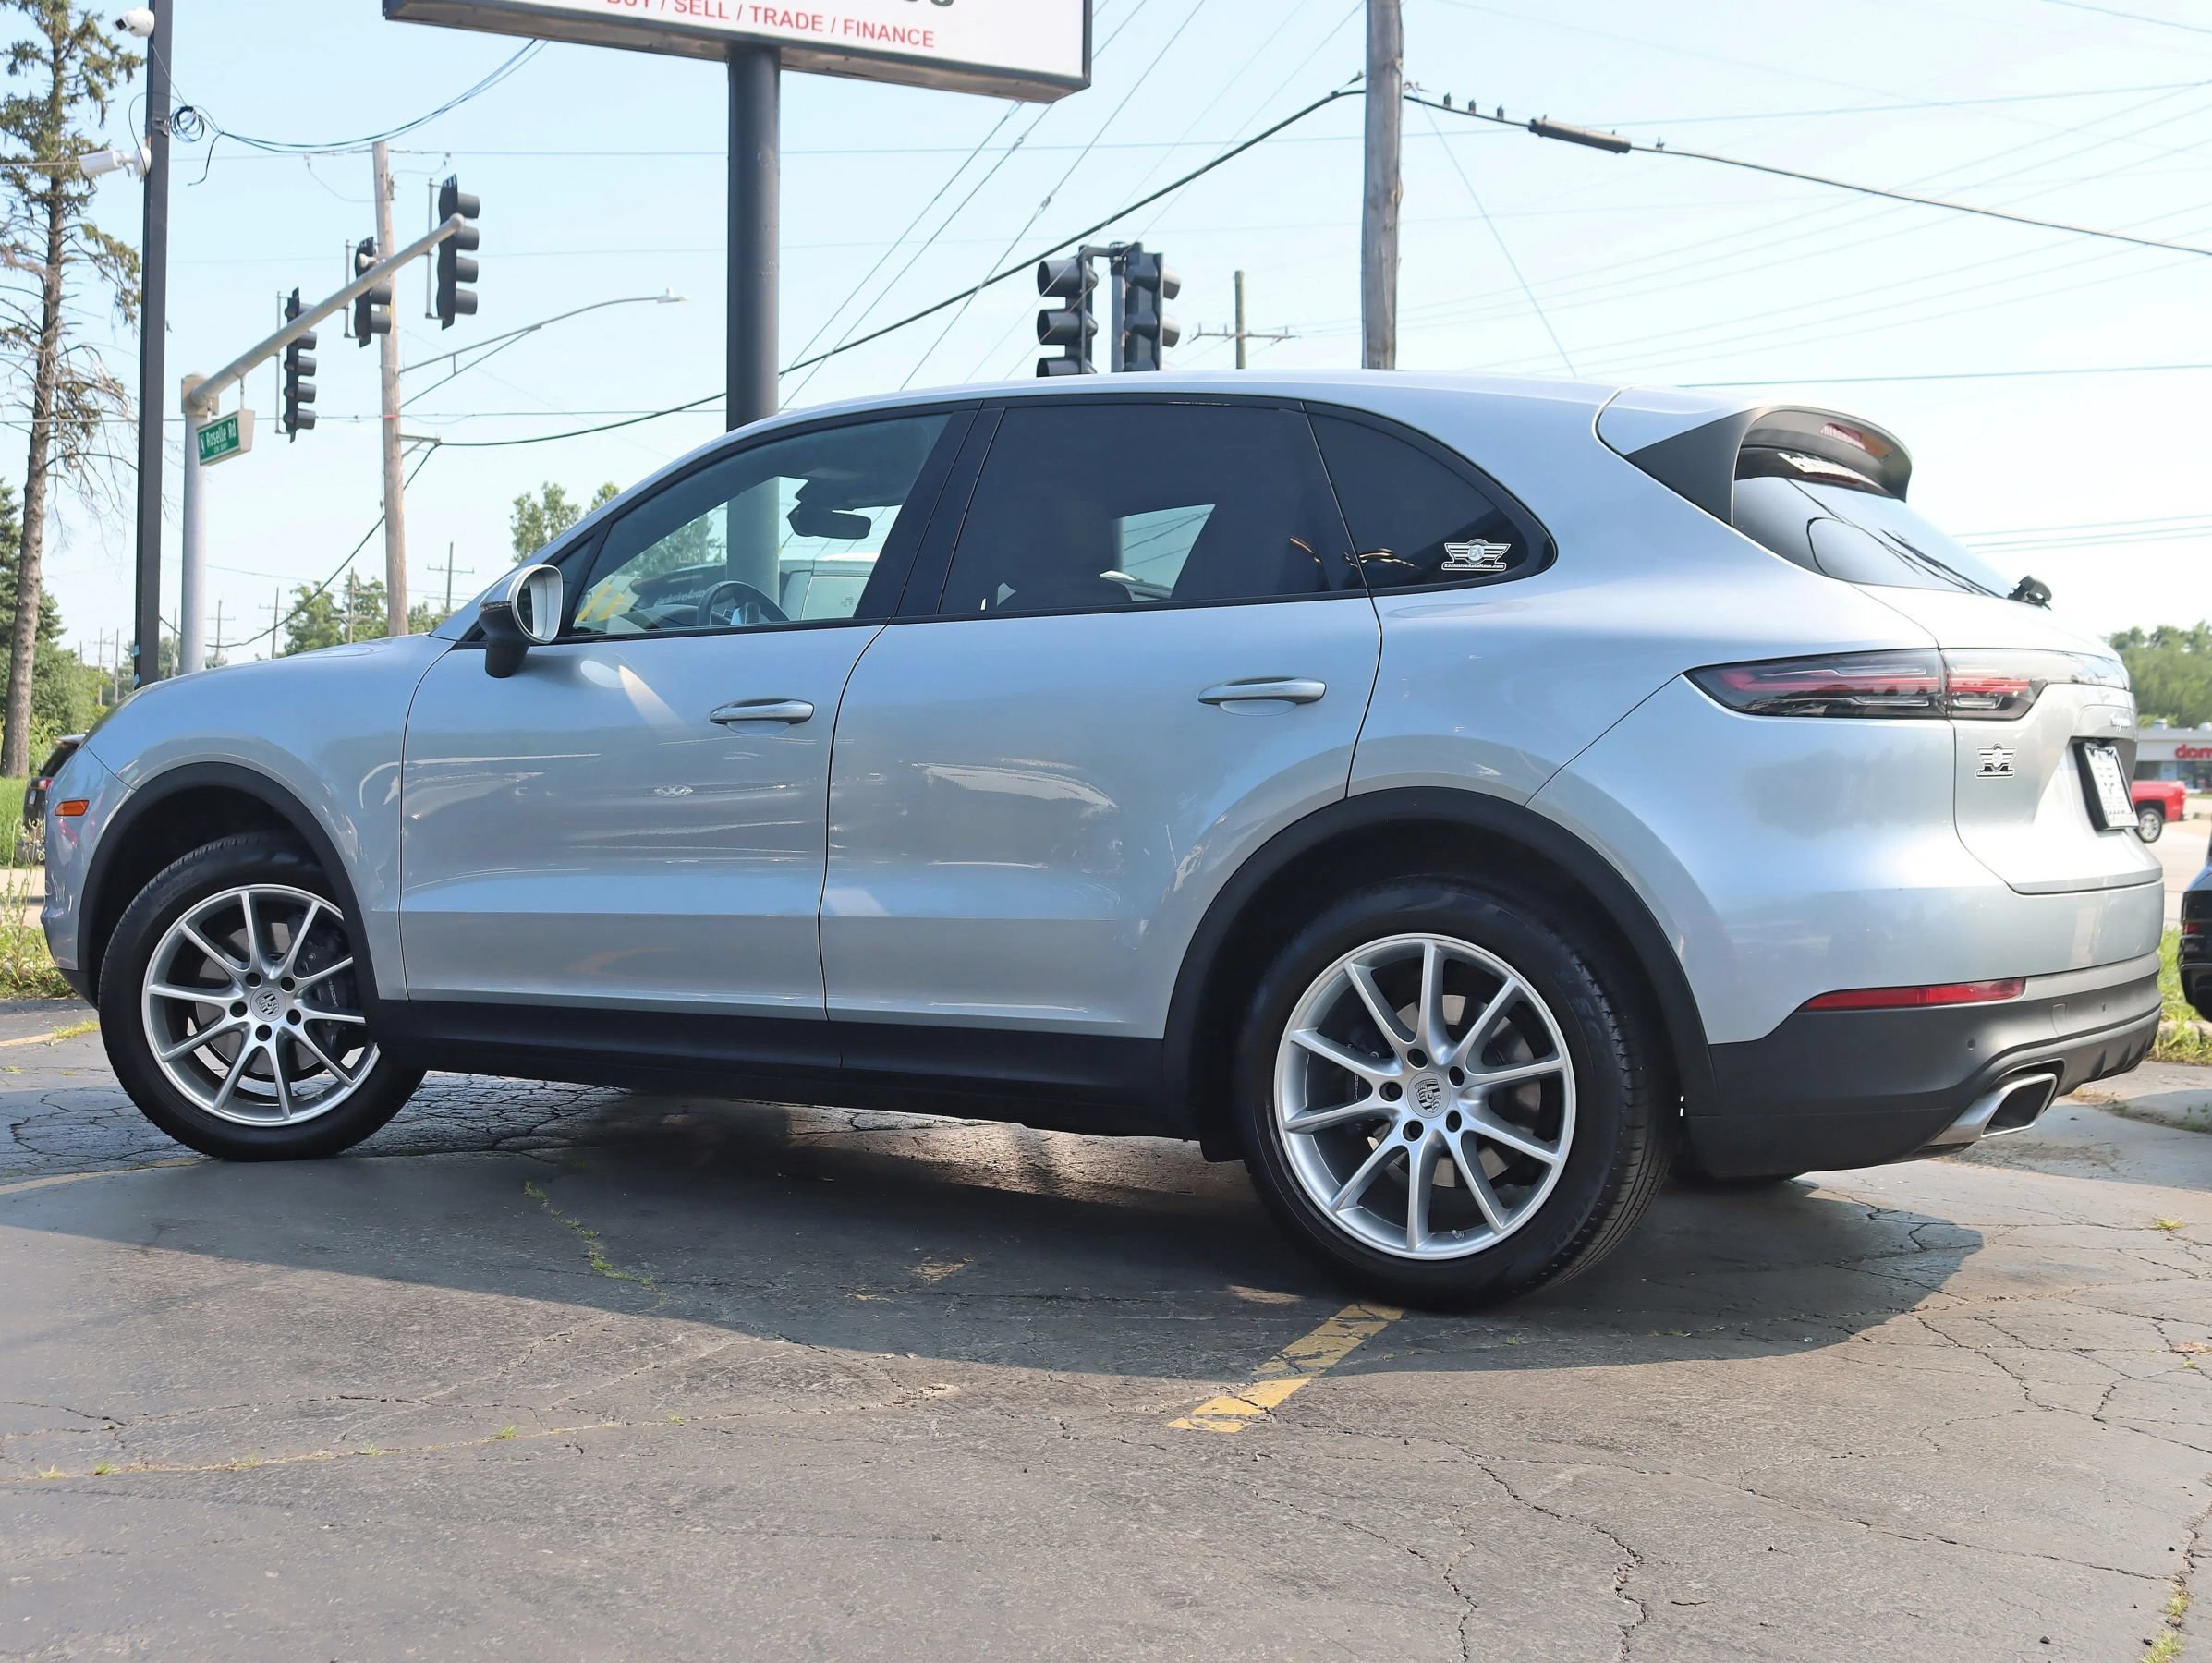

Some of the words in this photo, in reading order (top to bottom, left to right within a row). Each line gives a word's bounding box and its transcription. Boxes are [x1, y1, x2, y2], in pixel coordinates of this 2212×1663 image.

[674, 0, 730, 19] SELL
[736, 4, 743, 21] /
[749, 6, 824, 32] TRADE
[831, 17, 837, 34] /
[843, 18, 935, 48] FINANCE
[206, 425, 226, 448] Roselle
[228, 420, 237, 439] Rd
